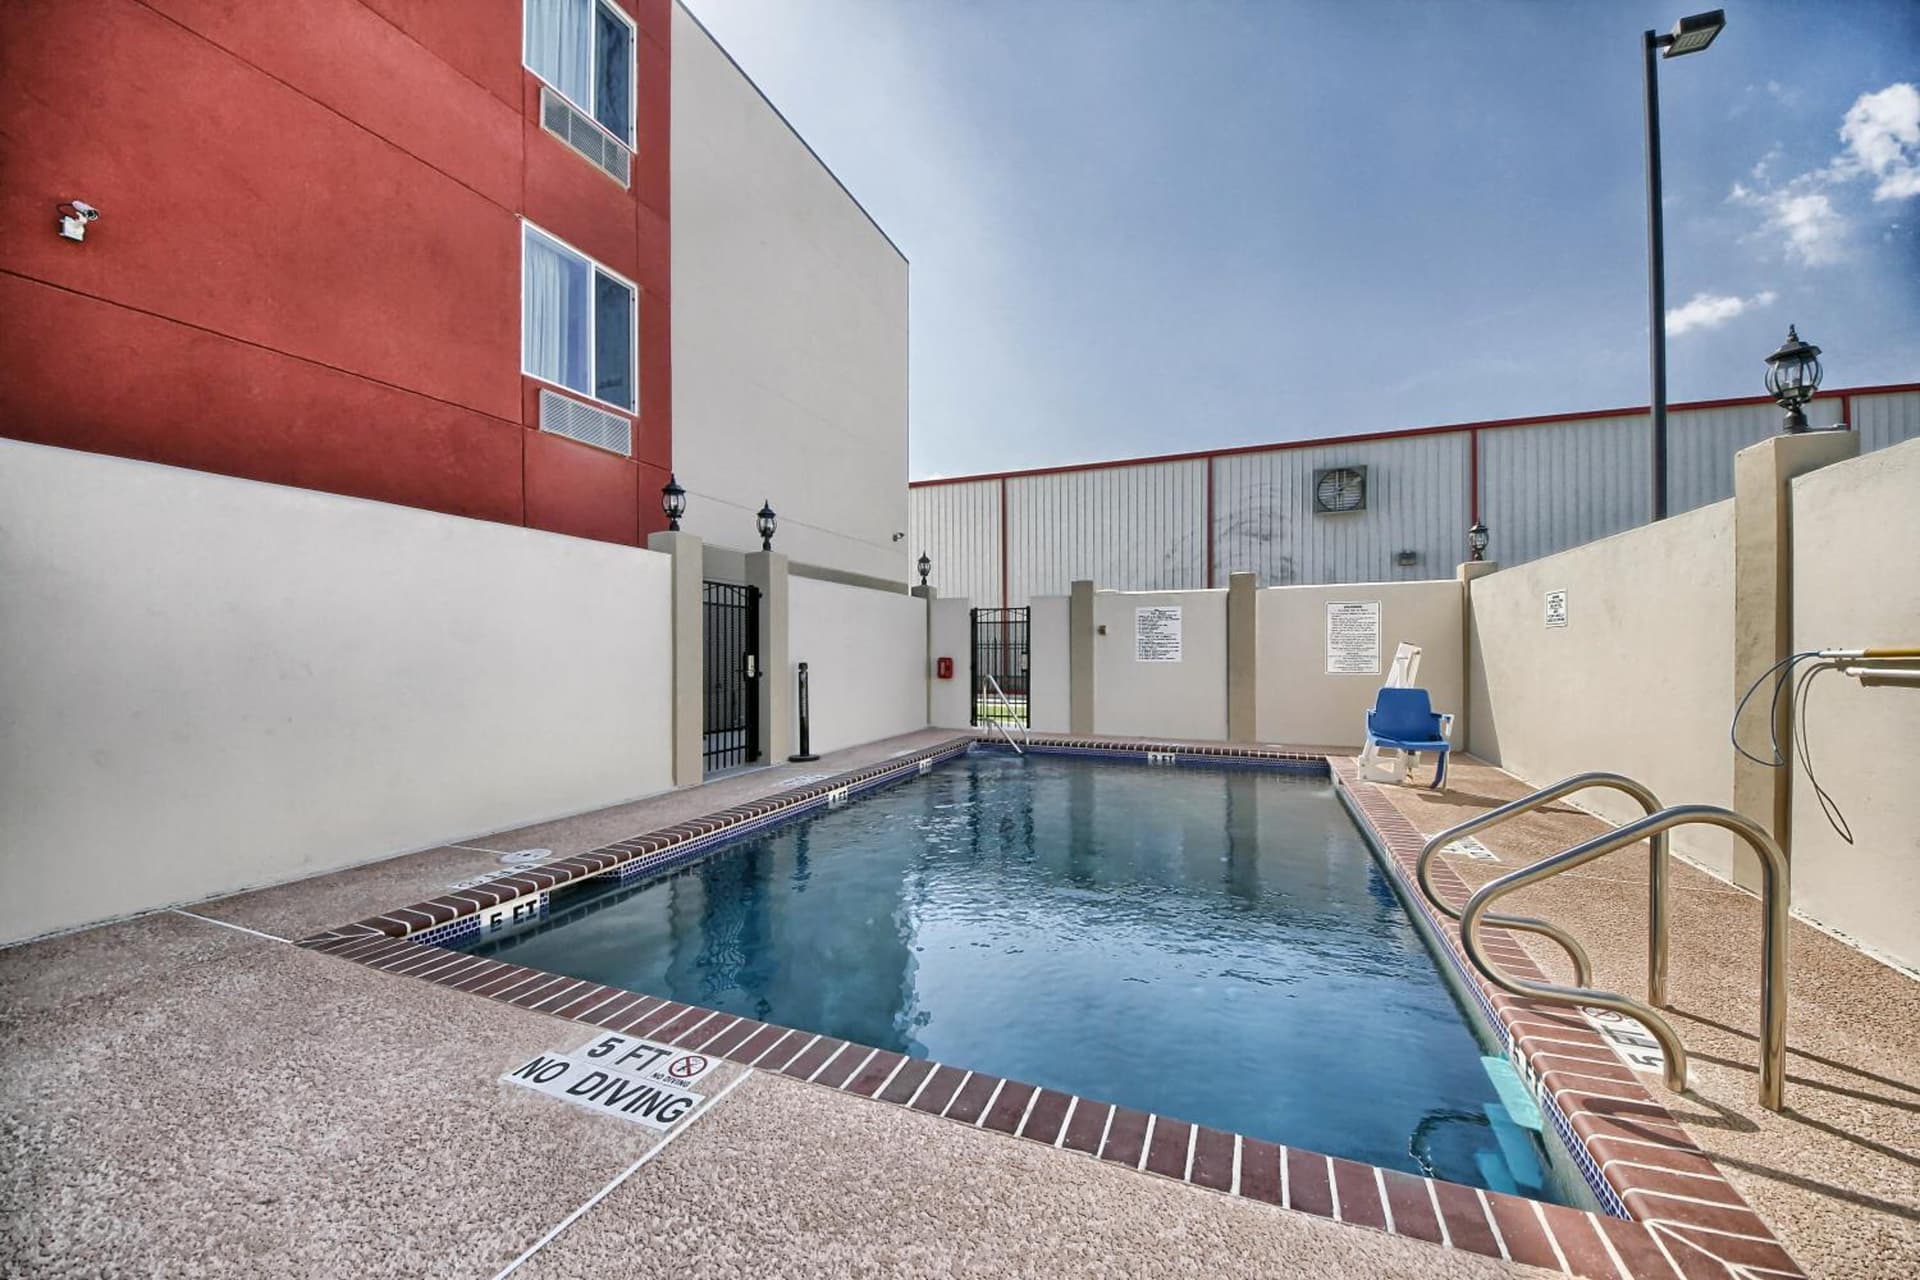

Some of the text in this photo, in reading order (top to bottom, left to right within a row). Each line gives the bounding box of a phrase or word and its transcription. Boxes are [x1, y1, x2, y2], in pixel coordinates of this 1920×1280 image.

[491, 899, 537, 928] 5 FT
[587, 1037, 672, 1071] 5 FT
[512, 1056, 694, 1123] NO DIVING
